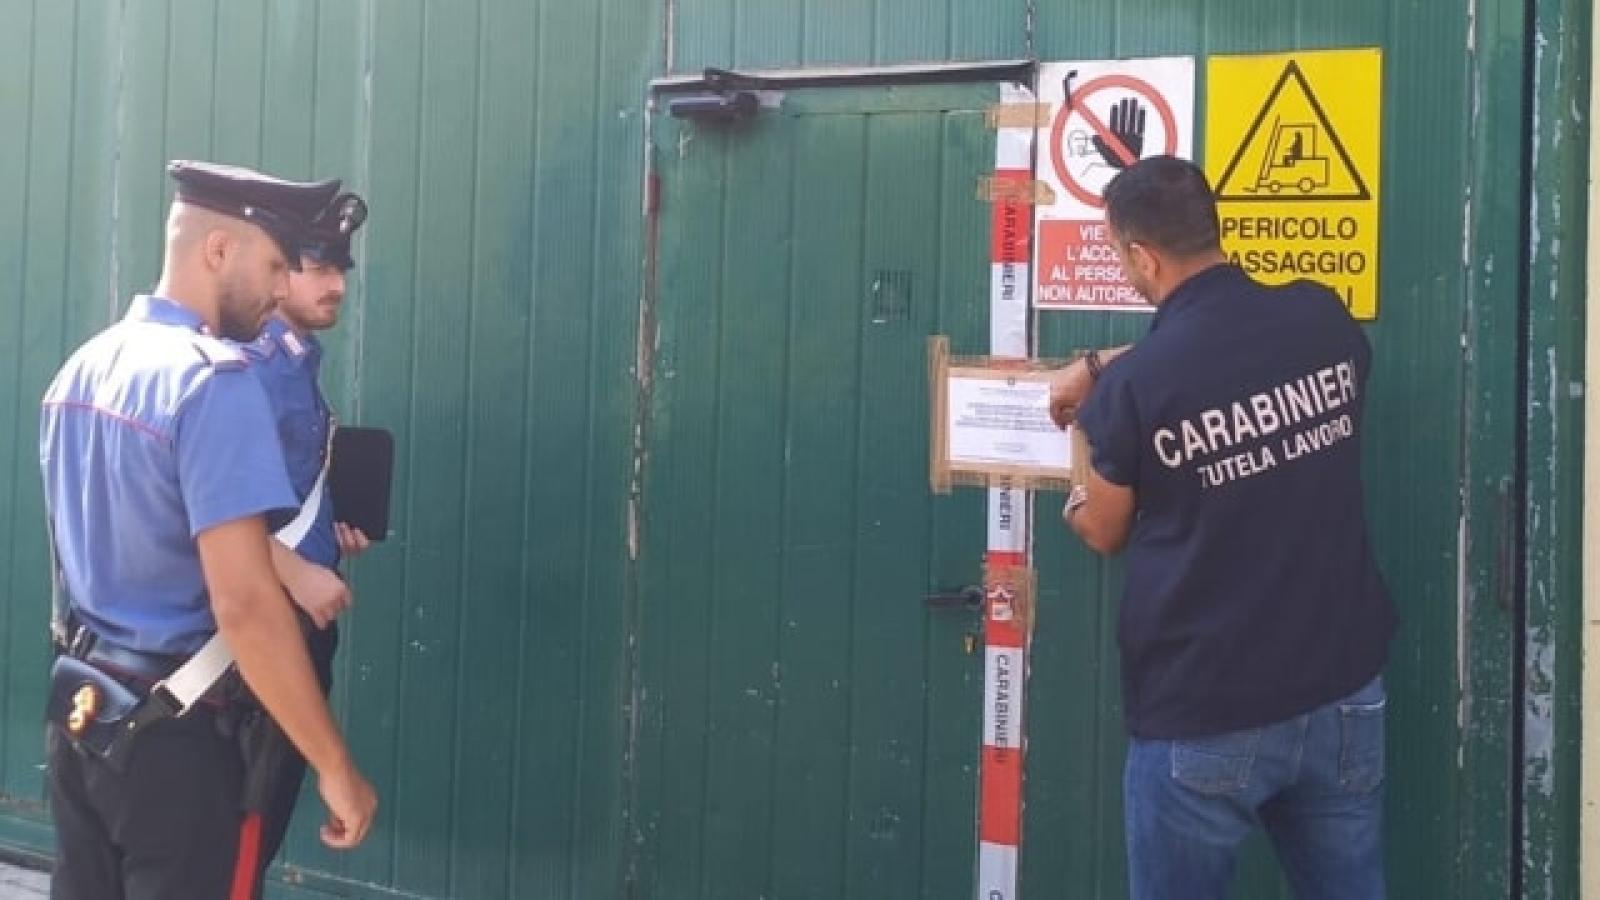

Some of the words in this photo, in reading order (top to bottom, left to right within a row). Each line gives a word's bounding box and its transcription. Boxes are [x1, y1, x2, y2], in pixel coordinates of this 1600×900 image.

[1080, 225, 1106, 241] VIE
[1222, 216, 1358, 240] PERICOLO
[1050, 264, 1074, 281] AL
[1226, 250, 1366, 275] ASSAGGIO
[1039, 284, 1071, 301] NON
[1197, 446, 1277, 488] TUTELA
[1282, 414, 1353, 461] LAVORO
[993, 654, 1010, 763] CARABINIERI
